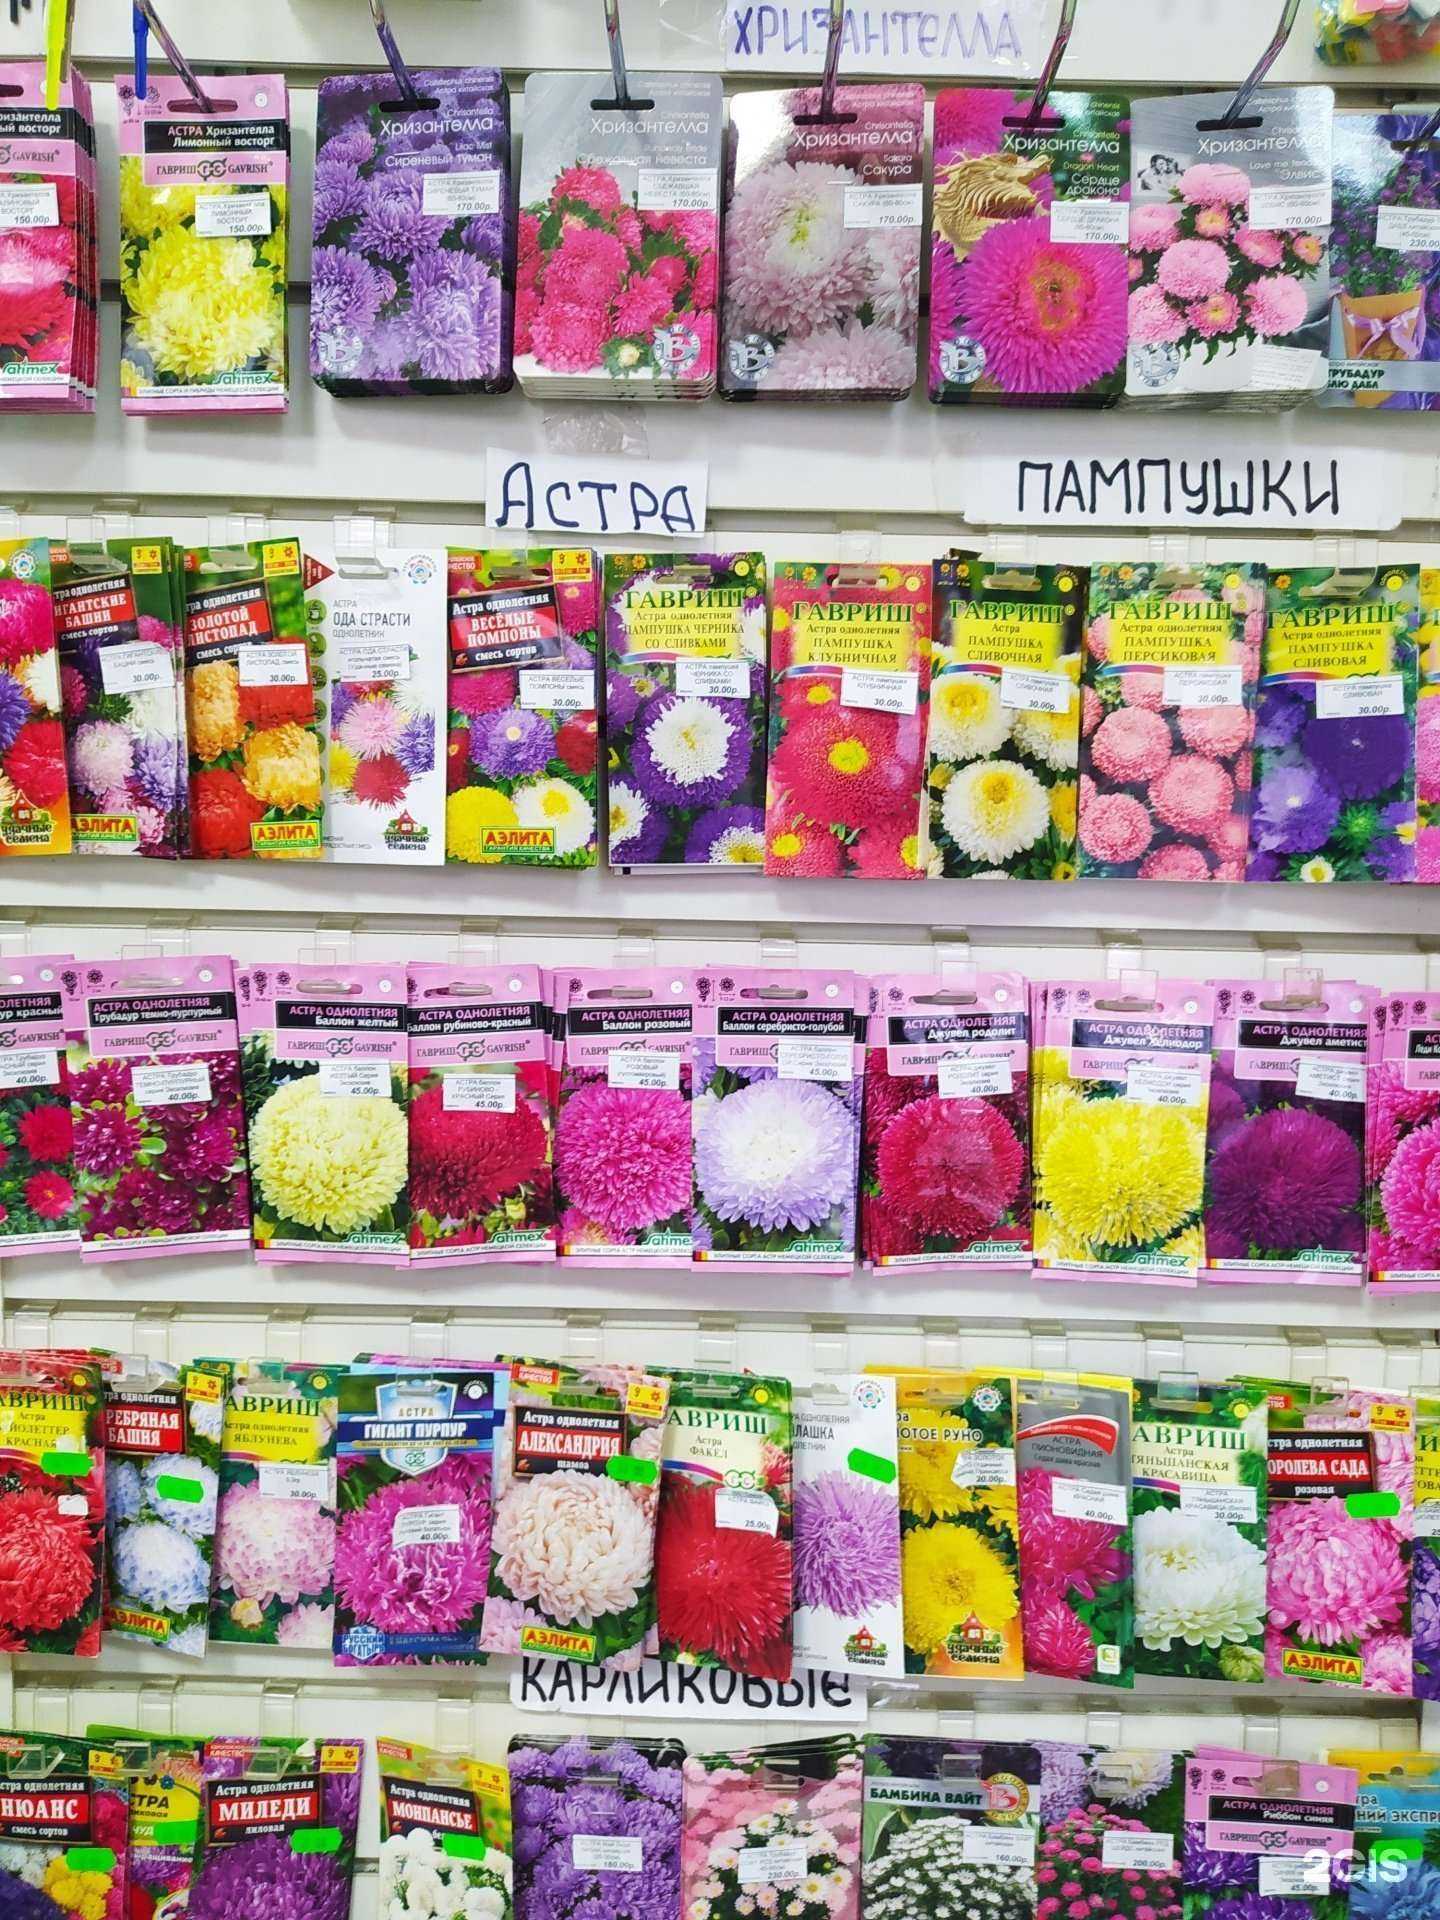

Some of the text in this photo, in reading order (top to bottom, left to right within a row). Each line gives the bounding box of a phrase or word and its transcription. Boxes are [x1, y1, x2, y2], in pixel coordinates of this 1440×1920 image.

[18, 123, 61, 135] восторг
[168, 126, 274, 138] АСТРА Хризантелла
[380, 119, 493, 136] Хризантелла
[590, 118, 709, 135] Хризантелла
[173, 137, 274, 147] Лимонный восторг
[794, 130, 913, 148] Хризантелла
[1003, 134, 1120, 154] Хризантелла
[385, 153, 492, 168] Сиреневый туман
[156, 165, 196, 176] ГАВРИШ
[228, 163, 268, 174] GAVRISH
[863, 164, 912, 177] Сакура
[1071, 173, 1121, 187] Сердце
[1065, 185, 1121, 197] дракона
[1019, 459, 1339, 516] ПАМПУШКИ
[70, 577, 125, 598] однолетняя
[203, 587, 261, 610] однолетняя
[333, 600, 358, 608] АСТРА
[453, 592, 550, 616] Астра однолетняя
[626, 590, 744, 609] ГАВРИШ
[635, 610, 733, 621] Астра однолетняя
[792, 601, 913, 623] ГАВРИШ
[950, 599, 1063, 625] ГАВРИШ
[1108, 601, 1232, 621] ГАВРИШ
[1267, 603, 1397, 628] ГАВРИШ
[65, 611, 112, 629] БАШНИ
[190, 605, 250, 632] ЗОЛОТОЙ
[333, 613, 411, 627] ОДА СТРАСТИ
[60, 625, 119, 641] смесь сортов
[624, 623, 745, 636] ПАМПУШКА ЧЕРНИКА
[807, 625, 901, 636] Астра однолетняя
[991, 624, 1020, 635] Астра
[1120, 623, 1222, 635] Астра однолетняя
[1281, 627, 1382, 641] Астра однолетняя
[467, 627, 542, 649] ПОМПОНЫ
[645, 638, 727, 649] СО СЛИВКАМИ
[813, 638, 893, 650] ПАМПУШКА
[968, 635, 1043, 649] ПАМПУШКА
[1125, 637, 1212, 648] ПАМПУШКА
[196, 647, 223, 660] смесь
[475, 645, 537, 662] смесь сортов
[1288, 641, 1374, 655] ПАМПУШКА
[808, 652, 897, 664] КЛУБНИЧНАЯ
[967, 650, 1043, 663] СЛИВОЧНАЯ
[1123, 650, 1216, 662] ПЕРСИКОВАЯ
[1293, 655, 1368, 669] СЛИВОВАЯ
[71, 818, 134, 834] АЭЛИТА
[256, 822, 316, 840] АЭЛИТА
[485, 830, 552, 845] АЭЛИТА
[93, 996, 210, 1013] АСТРА ОДНОЛЕТНЯЯ
[289, 1005, 399, 1018] АСТРА ОДНОЛЕТНЯЯ
[94, 1006, 222, 1024] Трубадур темно-пурпурный
[418, 1005, 530, 1021] АСТРА ОДНОЛЕТНЯЯ
[581, 1009, 690, 1021] АСТРА ОДНОЛЕТНЯЯ
[732, 1012, 845, 1023] АСТРА ОДНОЛЕТНЯЯ
[315, 1015, 399, 1029] Баллон желтый
[443, 1016, 532, 1033] рубиново-красный
[602, 1019, 691, 1032] Баллон розовый
[722, 1020, 845, 1033] Баллон серебристо-голубой
[904, 1016, 1016, 1030] АСТРА ОДНОЛЕТНЯЯ
[928, 1026, 1016, 1041] Джувел родолит
[1089, 1024, 1123, 1035] АСТРА
[1253, 1025, 1367, 1038] АСТРА ОДНОЛЕТНЯЯ
[288, 1040, 325, 1051] ГАВРИШ
[354, 1042, 393, 1053] GAVRISH
[1280, 1035, 1367, 1048] Джувел аметист
[121, 1391, 177, 1405] однолетняя
[398, 1407, 434, 1418] АСТРА
[523, 1411, 620, 1430] Астра однолетняя
[252, 1423, 310, 1435] однолетняя
[364, 1422, 467, 1439] ГИГАНТ ПУРПУР
[943, 1429, 983, 1442] РУНО
[109, 1426, 161, 1447] БАШНЯ
[233, 1433, 298, 1447] ЯБЛУНЕВА
[695, 1434, 722, 1447] Астра
[1295, 1437, 1363, 1450] однолетняя
[519, 1430, 620, 1459] АЛЕКСАНДРИЯ
[689, 1446, 728, 1459] ФАКЕЛ
[1165, 1446, 1195, 1458] Астра
[557, 1459, 590, 1471] шамоа
[1131, 1455, 1229, 1472] ТЯНЬШАНСКАЯ
[1331, 1460, 1369, 1477] САДА
[1142, 1468, 1217, 1484] КРАСАВИЦА
[1295, 1485, 1336, 1498] розовая
[343, 1633, 383, 1645] РУССКИЙ
[525, 1630, 592, 1653] АЭЛИТА
[343, 1643, 385, 1659] БОГАТЫРЬ
[1286, 1649, 1358, 1675] АЭЛИТА
[521, 1656, 852, 1709] КАРЛИКОВЫЕ
[24, 1780, 85, 1793] однолетняя
[215, 1780, 314, 1797] Астра однолетняя
[390, 1784, 471, 1808] Астра однолетняя
[870, 1787, 983, 1806] БАМБИНА ВАЙТ
[0, 1798, 79, 1820] НЮАНС
[218, 1796, 312, 1822] МИЛЕДИ
[1223, 1799, 1334, 1815] АСТРА ОДНОЛЕТНЯЯ
[392, 1800, 473, 1829] МОНПАНСЬЕ
[1263, 1810, 1301, 1822] Риббон
[11, 1826, 69, 1838] смесь сортов
[245, 1823, 285, 1835] лиловая
